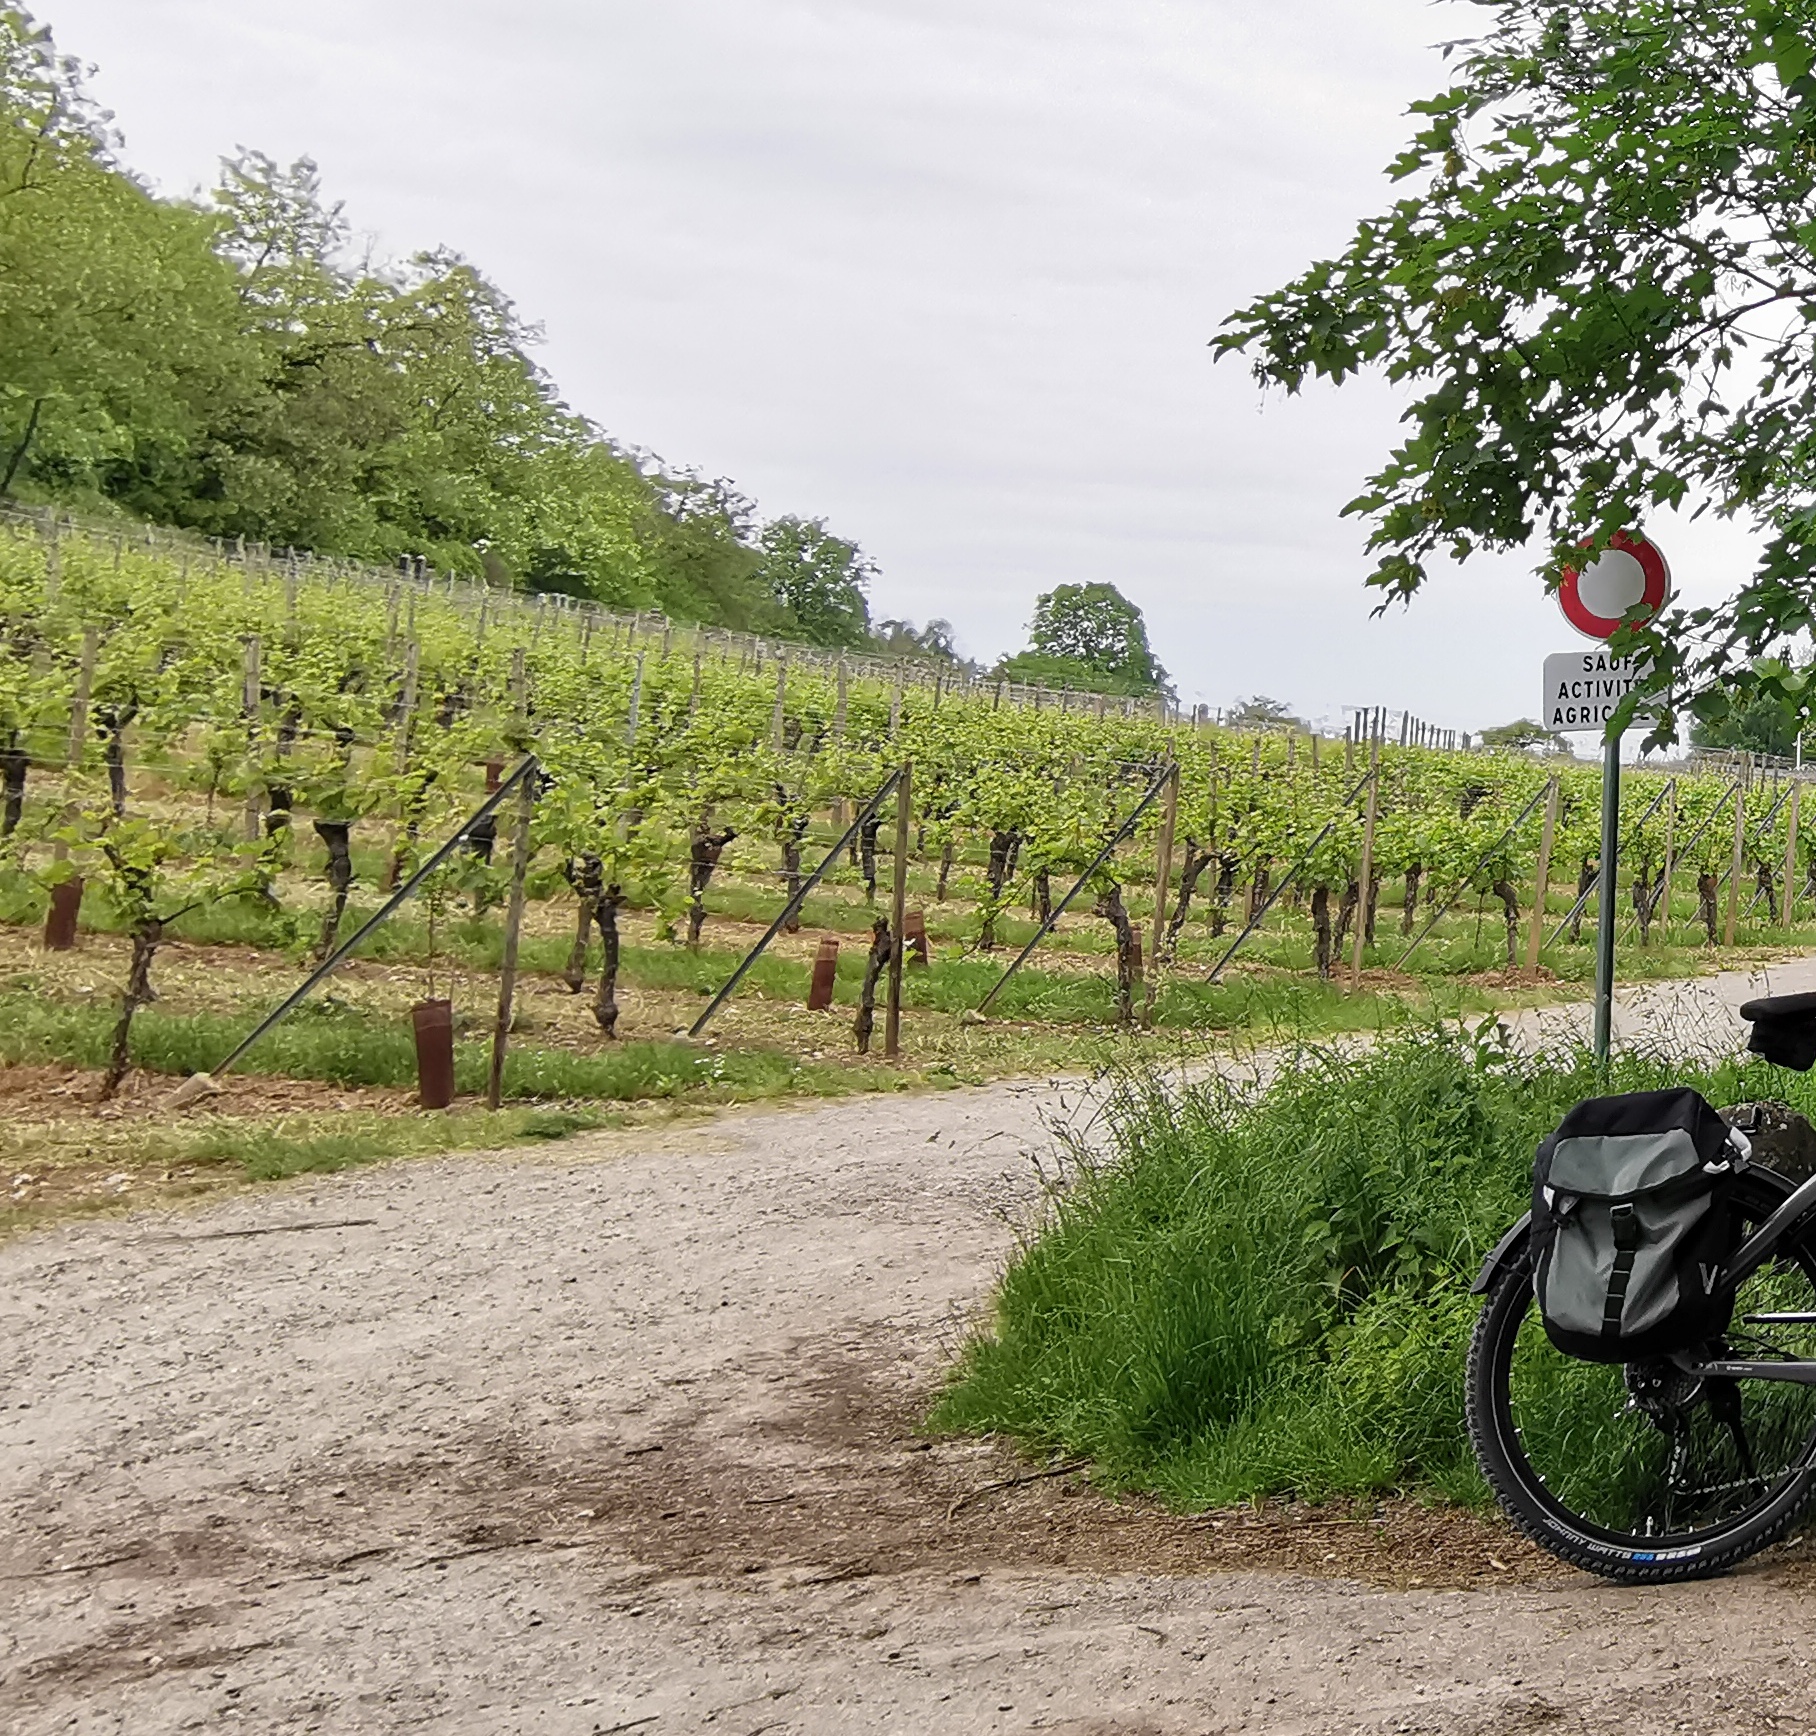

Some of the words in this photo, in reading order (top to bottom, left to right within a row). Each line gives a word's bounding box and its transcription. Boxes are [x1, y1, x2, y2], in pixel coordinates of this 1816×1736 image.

[1583, 654, 1633, 672] SAUF
[1558, 680, 1638, 699] ACTIVIT
[1543, 1518, 1587, 1546] JOHNNY
